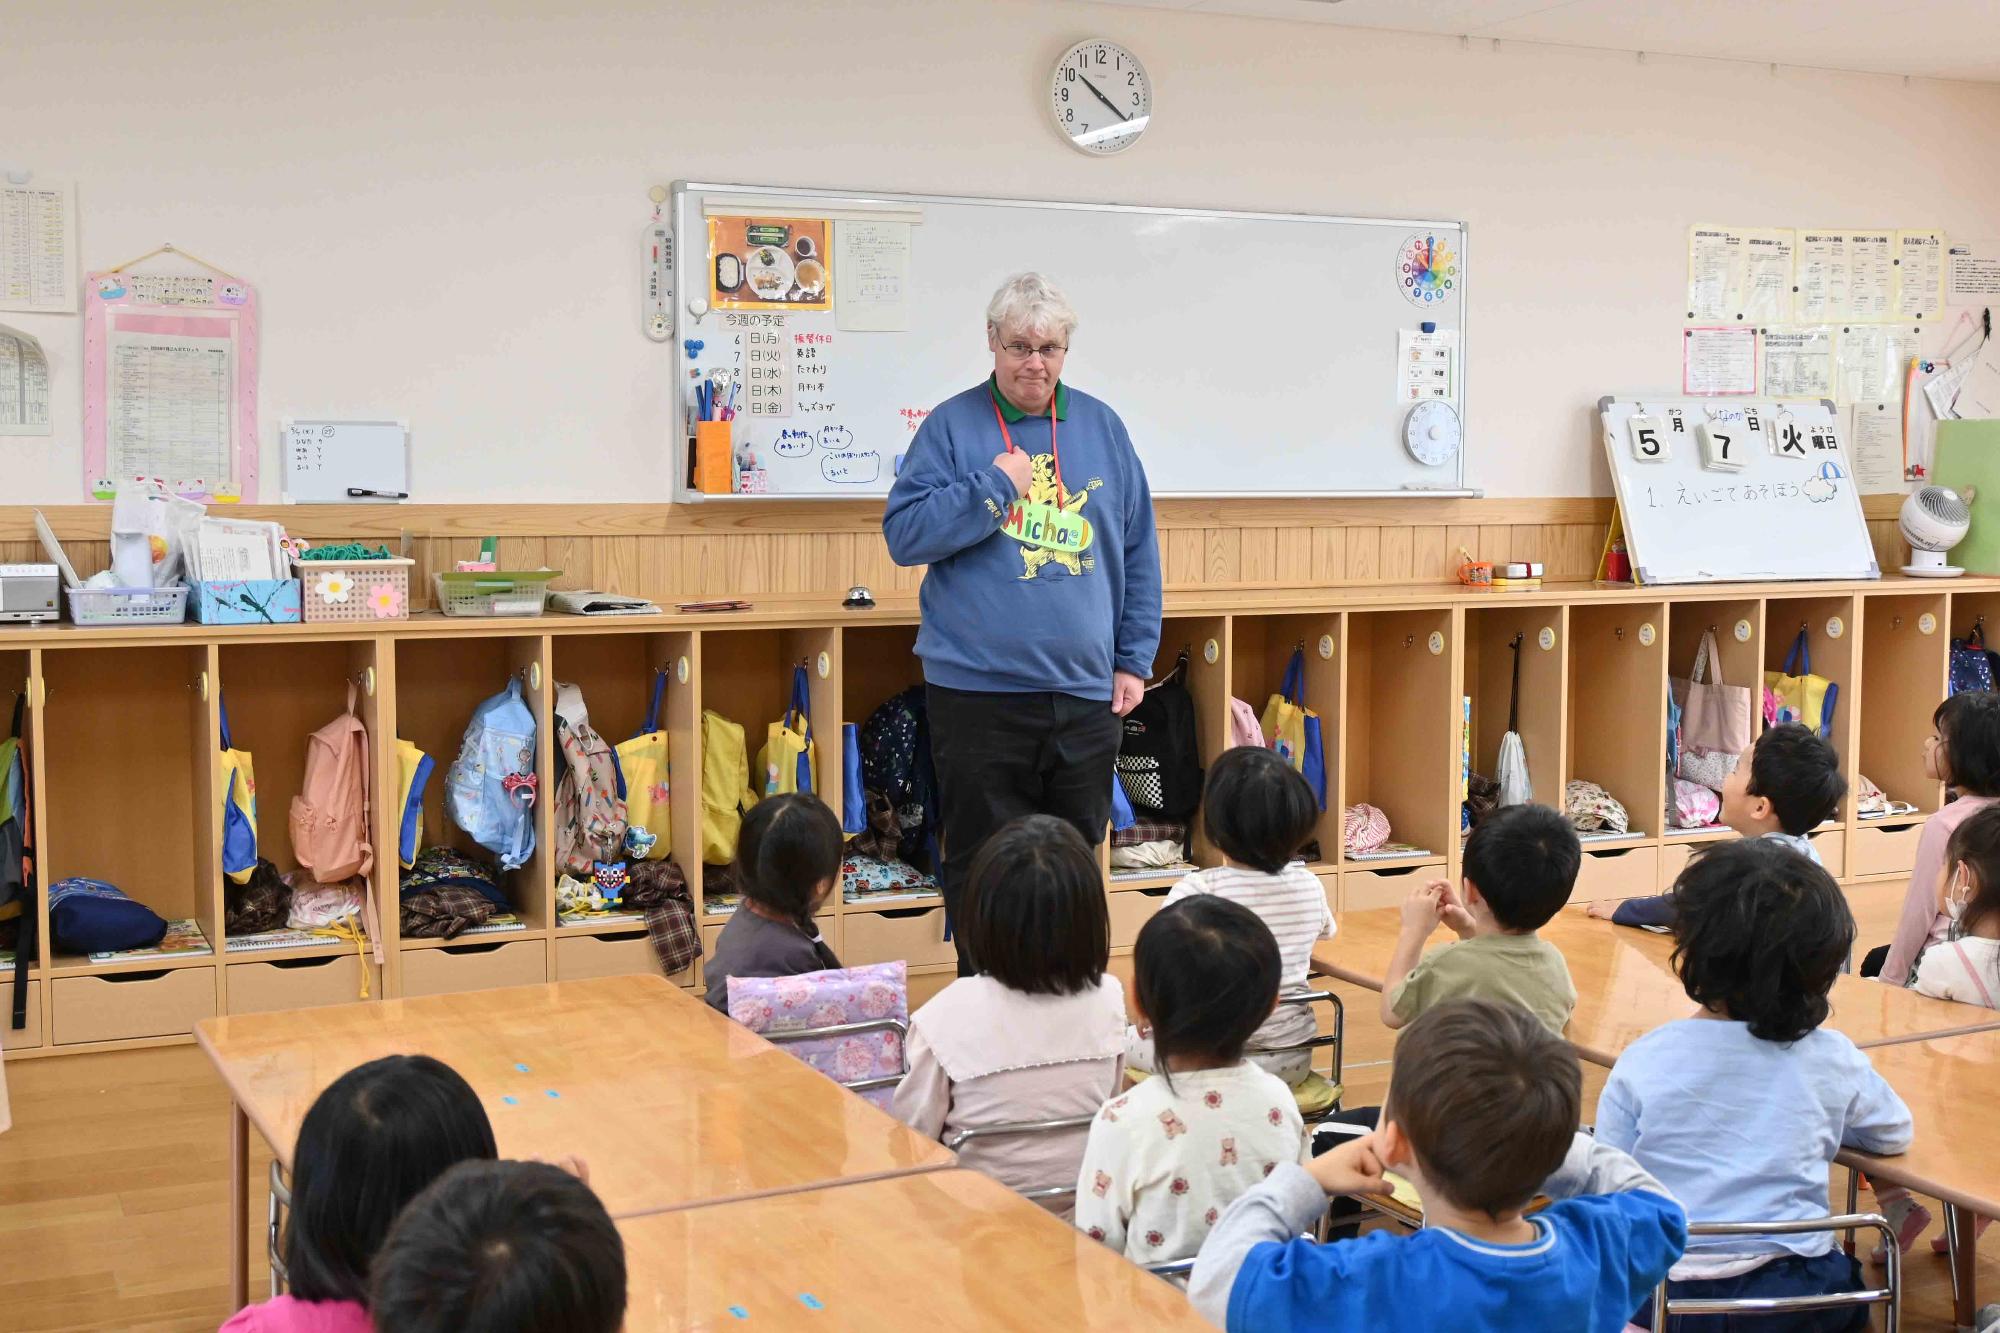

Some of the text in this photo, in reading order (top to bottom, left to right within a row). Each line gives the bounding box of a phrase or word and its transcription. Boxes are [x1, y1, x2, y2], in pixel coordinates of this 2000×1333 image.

[1080, 54, 1087, 68] 11
[1096, 49, 1106, 64] 12
[1116, 56, 1120, 70] 1
[1065, 67, 1075, 82] 10
[1128, 72, 1134, 86] 2
[1061, 88, 1069, 102] 9
[1132, 92, 1140, 106] 3
[1066, 109, 1074, 122] 8
[1081, 123, 1088, 134] 7
[726, 314, 784, 326] 今週の予定
[734, 333, 832, 344] 6 日(月) 振替休日
[734, 347, 816, 362] 7 日(火) 英語
[734, 364, 827, 379] 8 日(水) たてわり
[736, 383, 824, 396] 9 日(木) 月刊本
[752, 402, 782, 414] 日(金)
[798, 402, 836, 412] キッズヨガ
[1638, 417, 1838, 459] 5 月 7 日 火 曜日
[1648, 486, 1664, 508] 1.
[1003, 502, 1088, 547] Michael
